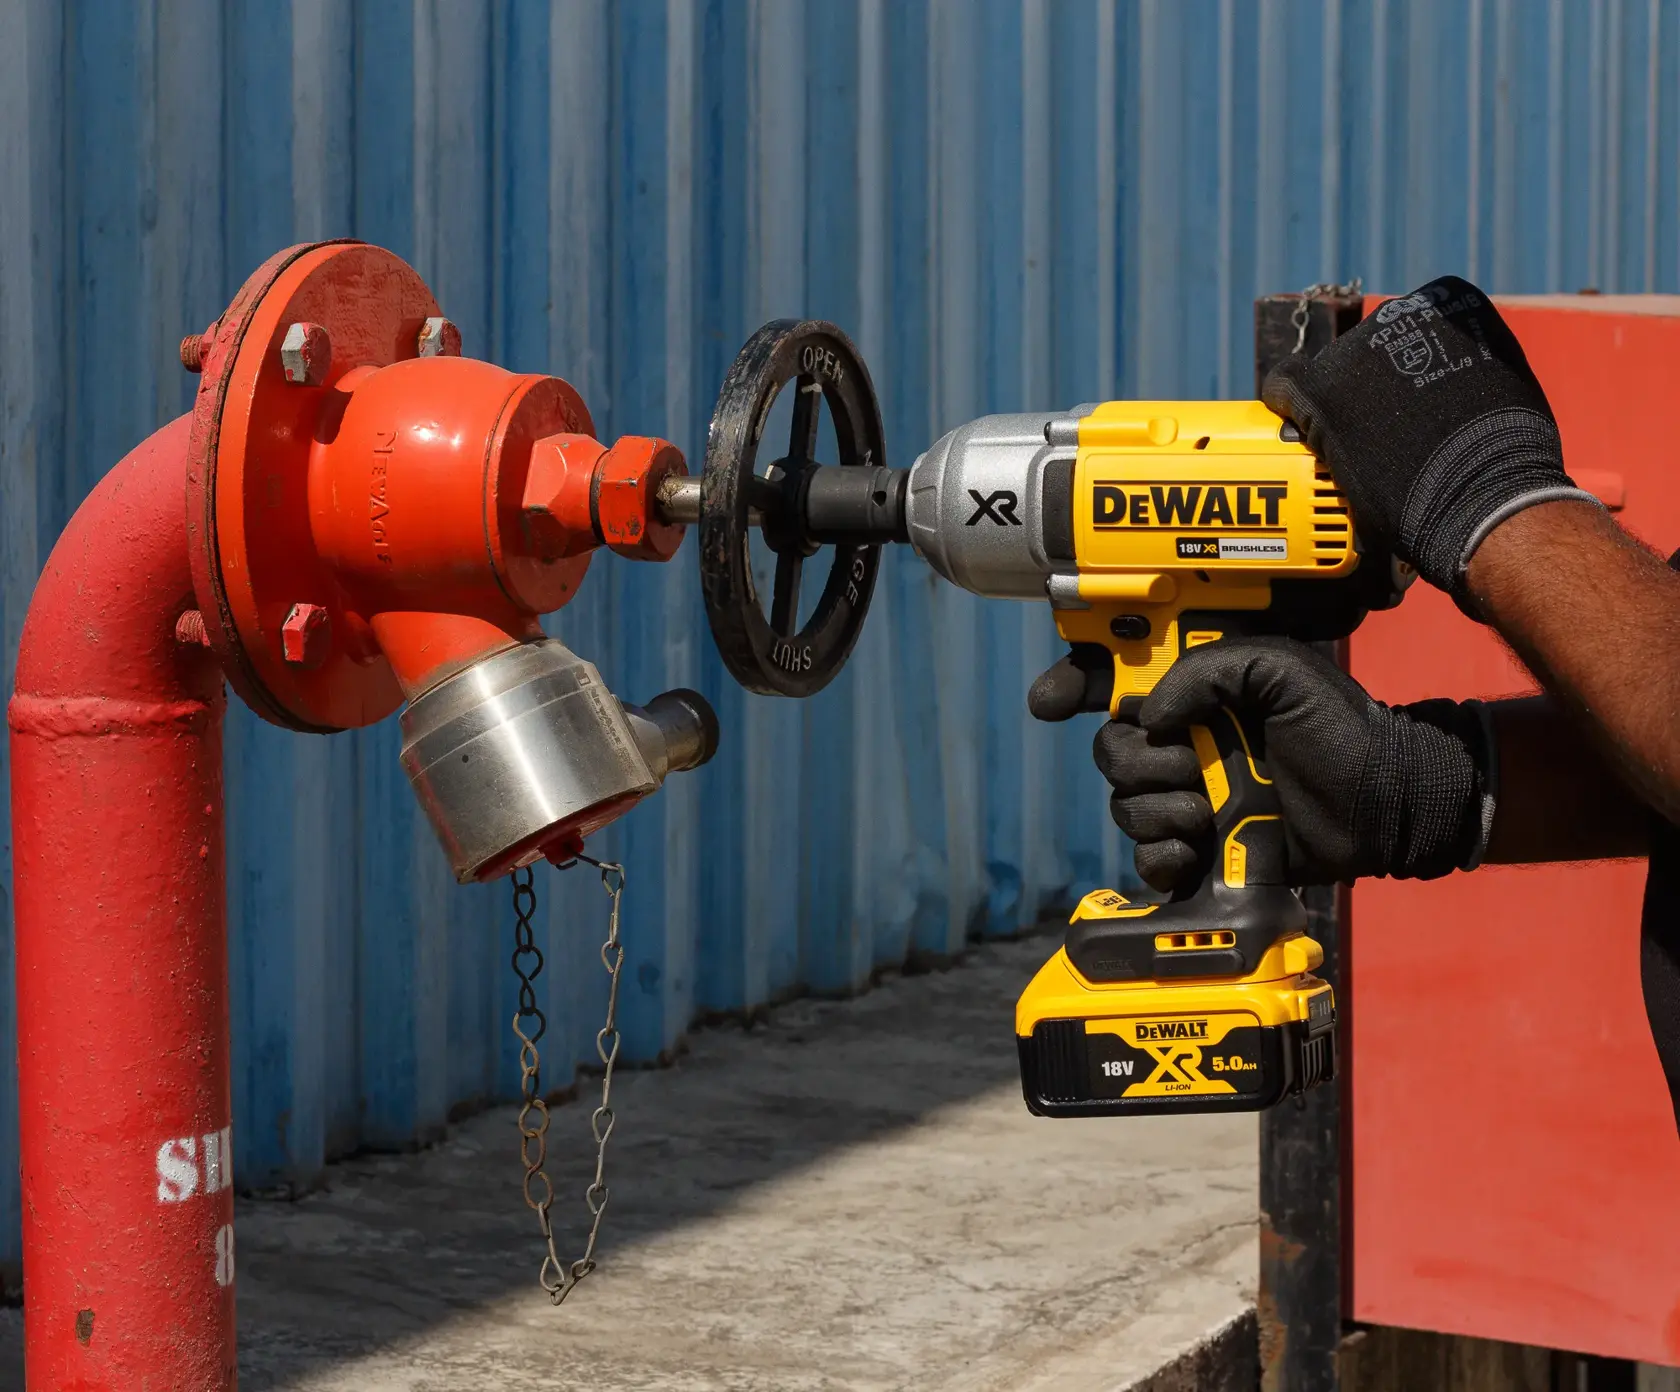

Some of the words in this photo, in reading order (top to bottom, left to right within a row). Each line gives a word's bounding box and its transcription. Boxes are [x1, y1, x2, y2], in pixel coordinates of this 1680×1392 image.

[1384, 329, 1424, 352] EN388
[802, 346, 845, 387] OPEN
[964, 488, 1023, 527] XR
[1179, 543, 1202, 554] 18V
[1203, 543, 1218, 554] XR
[1221, 545, 1285, 553] BRUSHLESS
[772, 644, 812, 672] SHUT
[1101, 1060, 1134, 1077] 18V
[1144, 1044, 1209, 1083] XR
[1165, 1083, 1191, 1091] LI-ION
